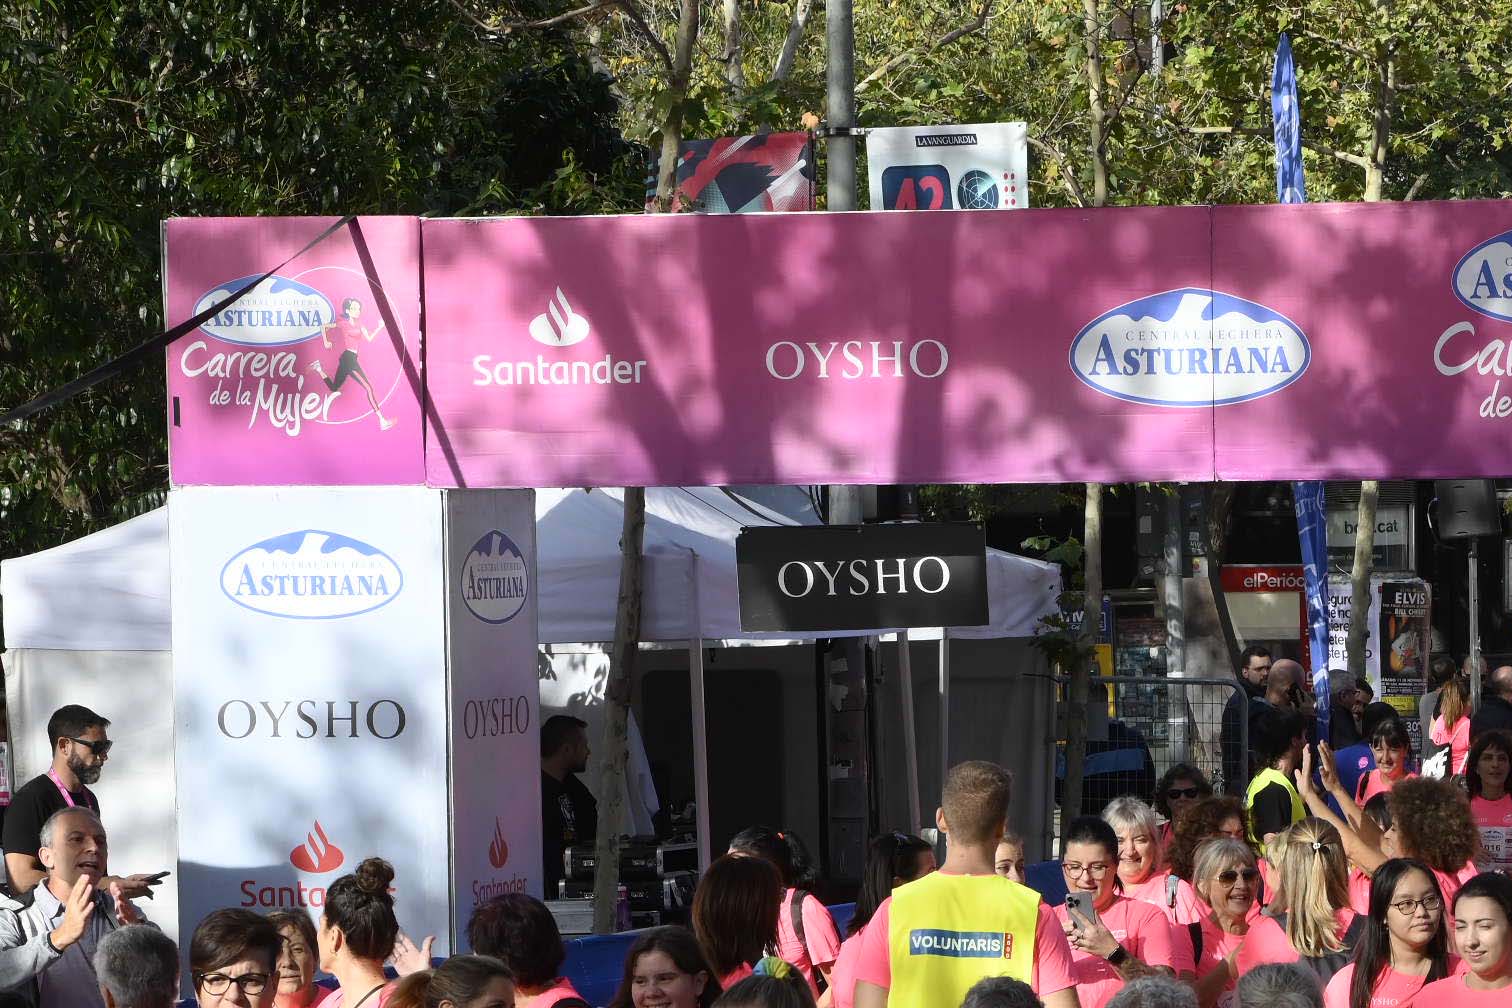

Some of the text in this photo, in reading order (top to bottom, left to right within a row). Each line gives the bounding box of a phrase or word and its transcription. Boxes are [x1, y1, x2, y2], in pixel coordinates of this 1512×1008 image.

[204, 300, 323, 327] ASTURIANA
[181, 341, 296, 378] Carrera
[473, 354, 646, 385] Santander
[765, 339, 948, 380] OYSHO
[1088, 333, 1292, 376] ASTURIANA
[210, 375, 342, 437] de la Mujer
[1479, 380, 1512, 417] de
[236, 564, 389, 596] ASTURIANA
[467, 569, 523, 600] ASTURIANA
[778, 556, 950, 597] OYSHO
[1395, 592, 1425, 605] ELVIS
[218, 700, 406, 739] OYSHO
[464, 695, 530, 739] OYSHO
[912, 936, 1000, 951] VOLUNTARIS
